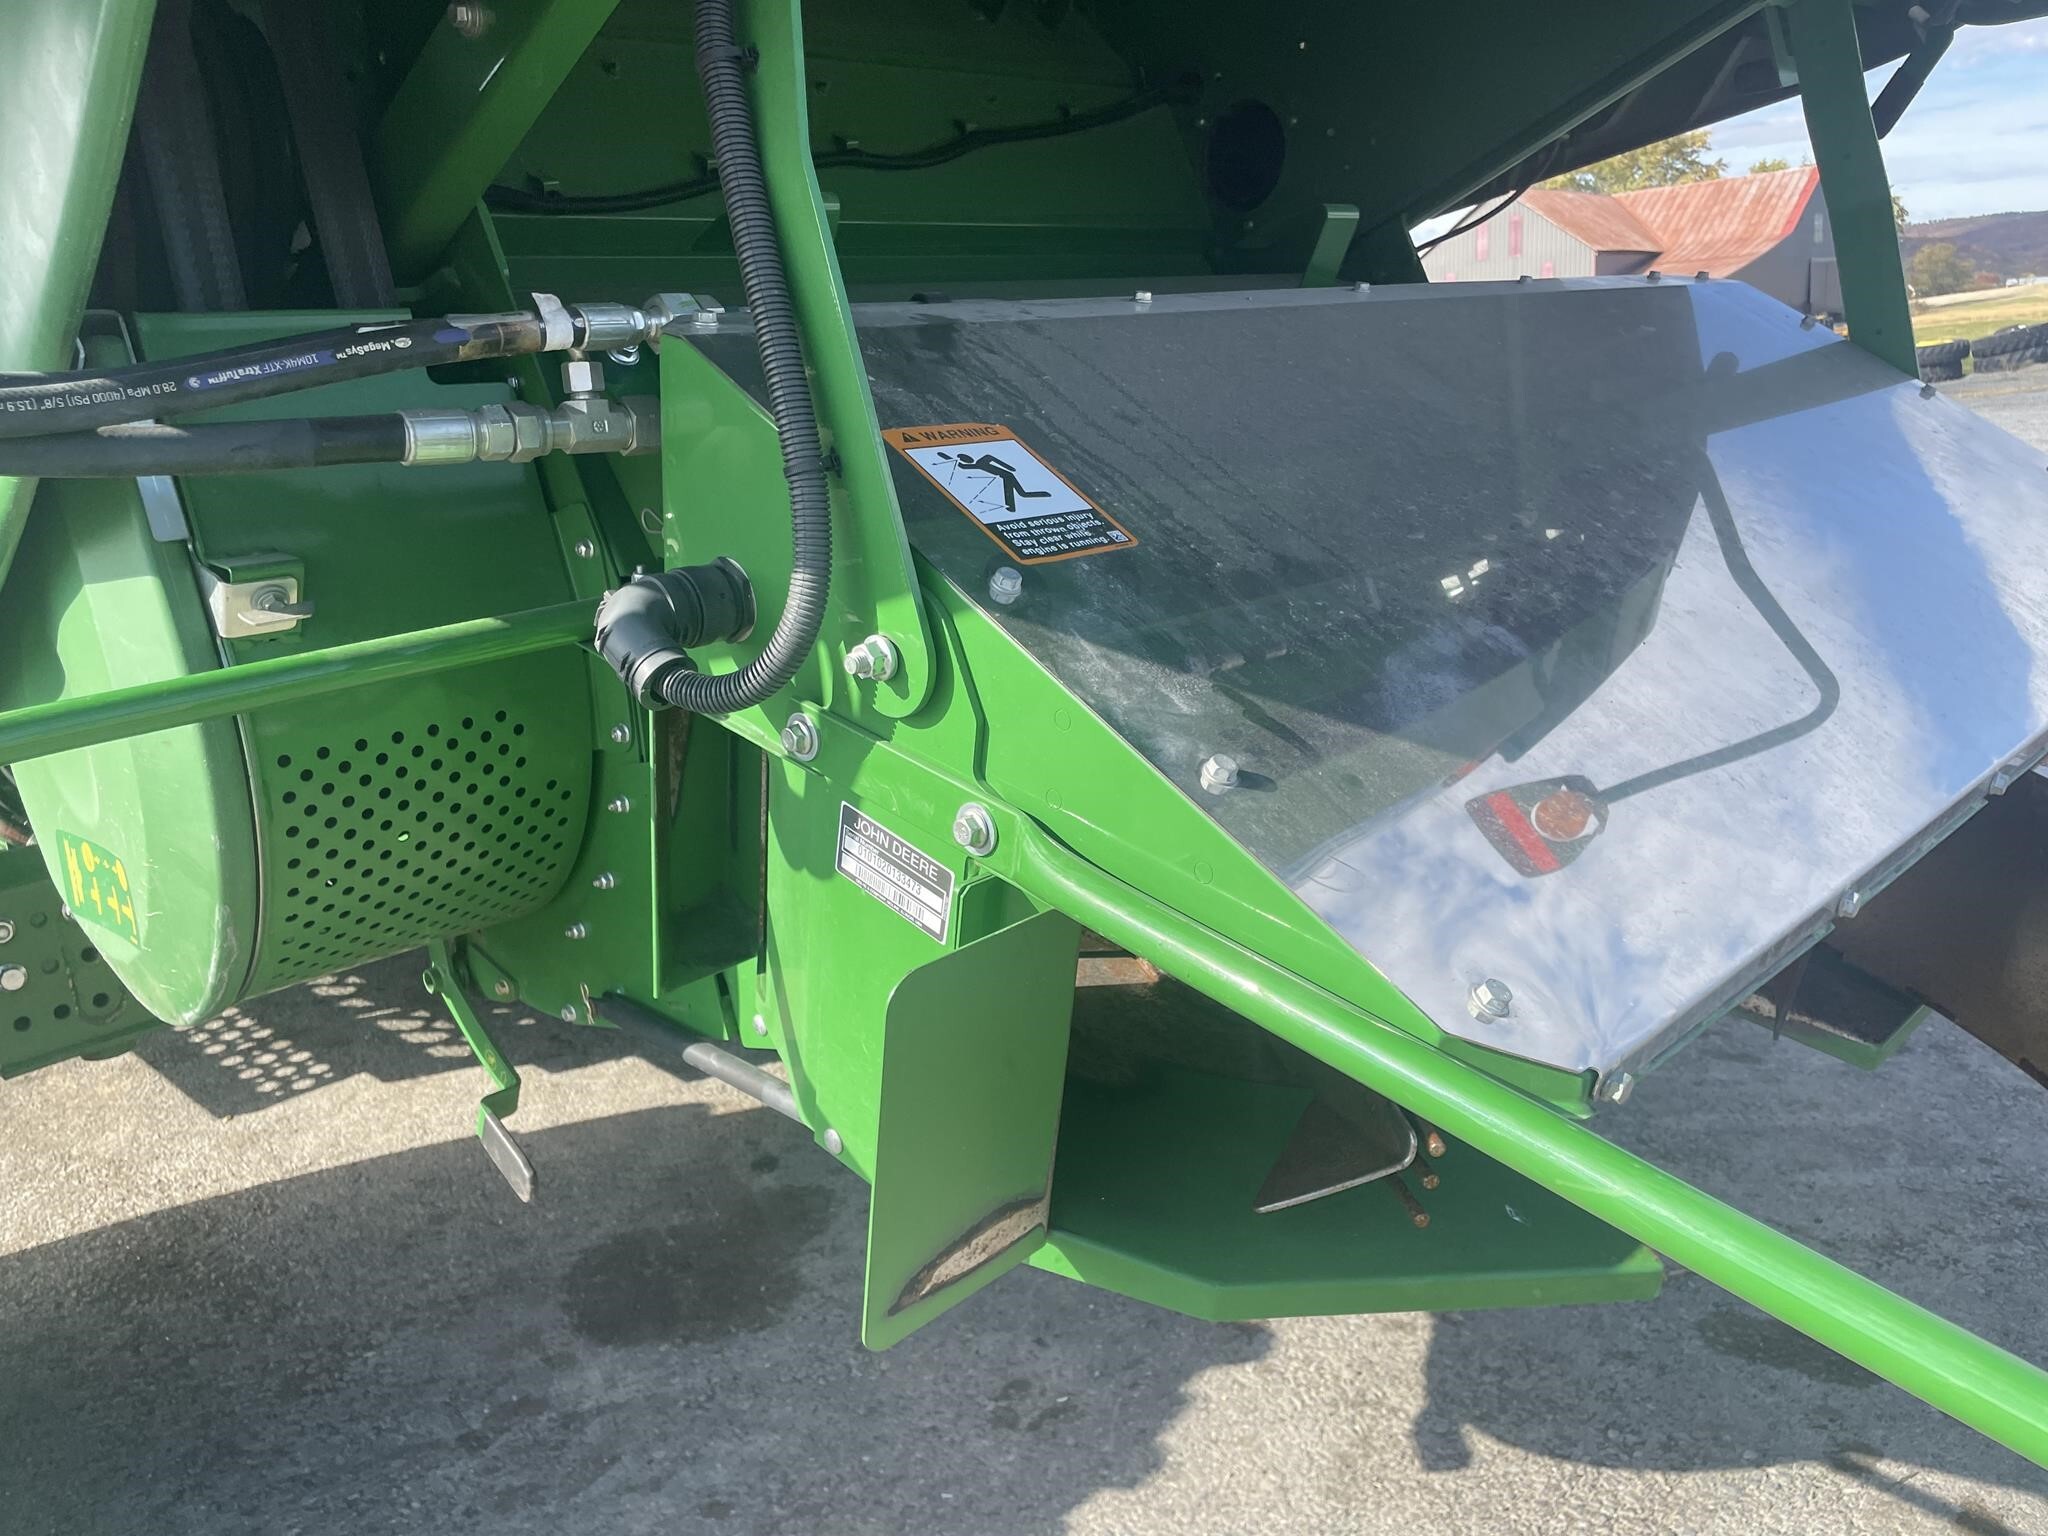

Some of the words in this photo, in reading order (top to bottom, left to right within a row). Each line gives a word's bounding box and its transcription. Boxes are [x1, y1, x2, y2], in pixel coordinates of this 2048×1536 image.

[263, 353, 320, 373] 10M4K-XTF
[126, 385, 151, 398] MPa
[152, 381, 177, 395] 28.0
[919, 425, 999, 441] WARNING
[996, 521, 1025, 533] Avoid
[1028, 516, 1063, 529] serious
[1064, 511, 1094, 524] injury
[1003, 528, 1030, 540] from
[1030, 525, 1066, 537] thrown
[1067, 518, 1105, 533] objects.
[1012, 536, 1039, 549] Stay
[1040, 532, 1064, 545] clear
[1064, 530, 1091, 543] while
[1021, 543, 1057, 557] engine
[1057, 542, 1068, 552] is
[1069, 536, 1110, 551] running.
[853, 817, 890, 849] JOHN
[892, 840, 939, 882] DEERE
